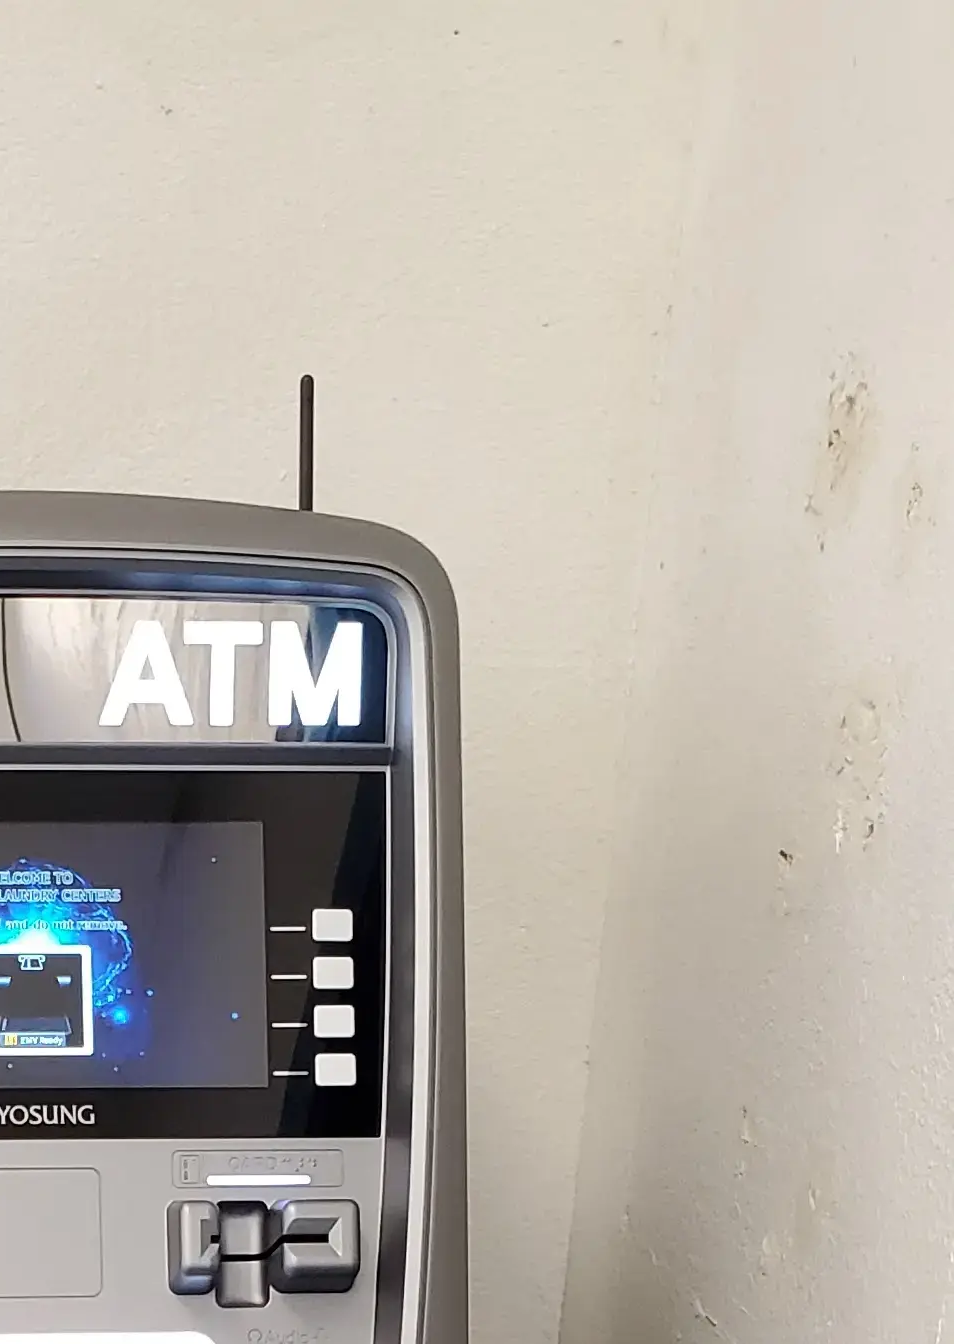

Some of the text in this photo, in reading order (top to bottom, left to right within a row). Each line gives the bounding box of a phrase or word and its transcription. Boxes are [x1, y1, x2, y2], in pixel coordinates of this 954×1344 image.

[98, 620, 363, 728] ATM
[53, 871, 74, 886] TO
[61, 888, 122, 903] CENTERS
[5, 918, 30, 931] and
[33, 918, 49, 931] do
[53, 918, 75, 931] not
